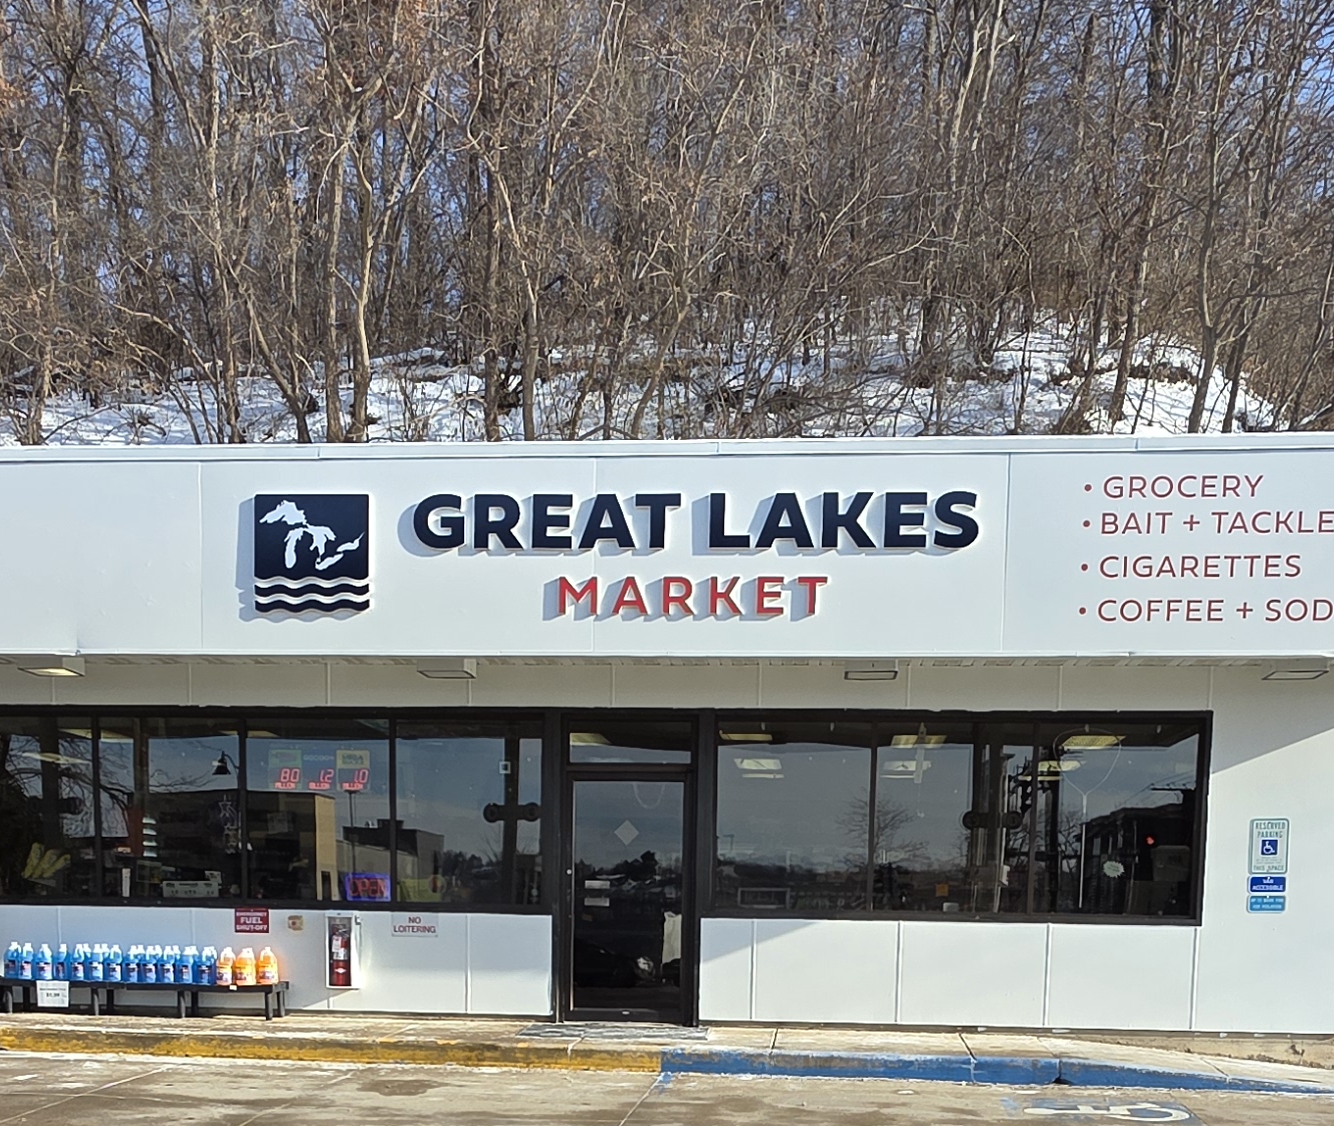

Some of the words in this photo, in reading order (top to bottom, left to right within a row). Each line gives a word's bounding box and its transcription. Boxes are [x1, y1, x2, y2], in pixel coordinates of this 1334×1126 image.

[1103, 474, 1264, 499] GROCERY
[412, 494, 685, 549] GREAT
[707, 492, 979, 549] LAKES
[1100, 512, 1173, 534] BAIT
[1183, 515, 1200, 531] +
[1099, 555, 1302, 578] CIGARETTES
[558, 576, 828, 616] MARKET
[1097, 600, 1224, 622] COFFEE
[1236, 602, 1253, 619] +
[280, 768, 300, 782] 80
[350, 877, 388, 897] OPEN
[240, 916, 263, 924] FUEL
[393, 925, 436, 933] LOITERING
[408, 916, 422, 924] NO
